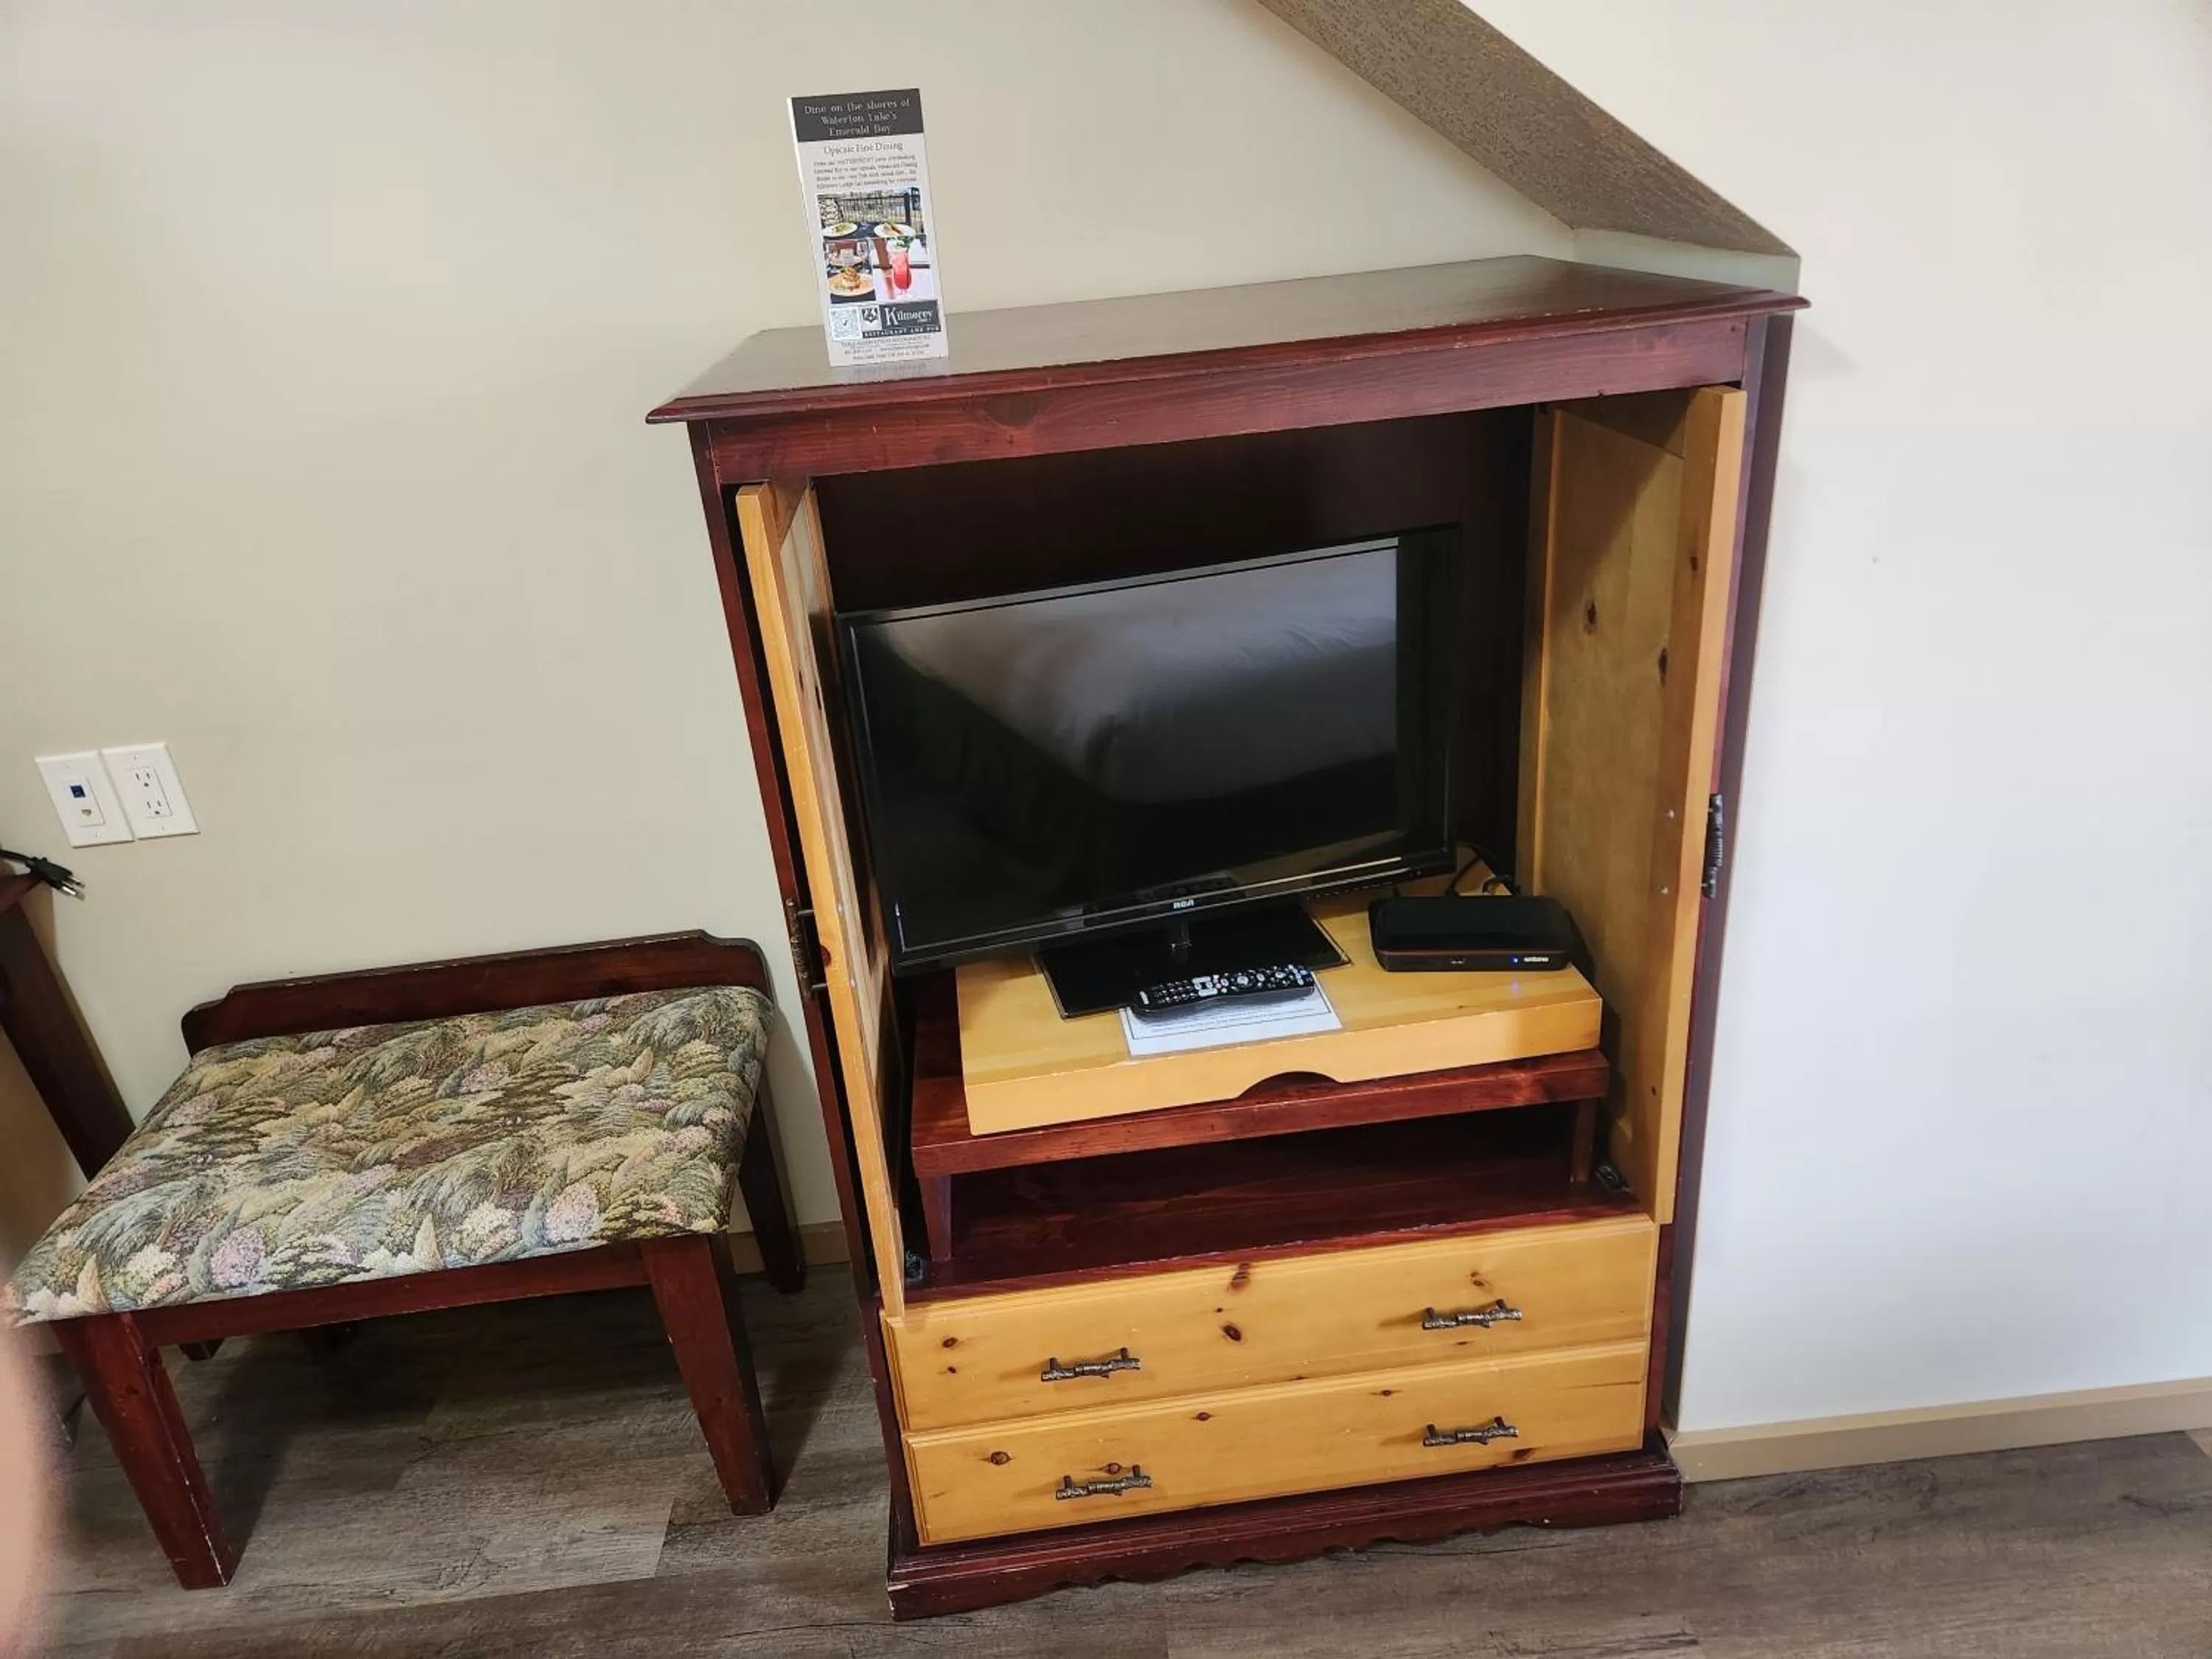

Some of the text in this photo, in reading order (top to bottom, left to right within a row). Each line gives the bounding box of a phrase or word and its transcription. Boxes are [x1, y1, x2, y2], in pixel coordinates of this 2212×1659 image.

[804, 105, 827, 114] Dine
[847, 102, 863, 112] the
[866, 100, 897, 110] shores
[900, 97, 910, 106] of
[829, 125, 869, 136] Emerald
